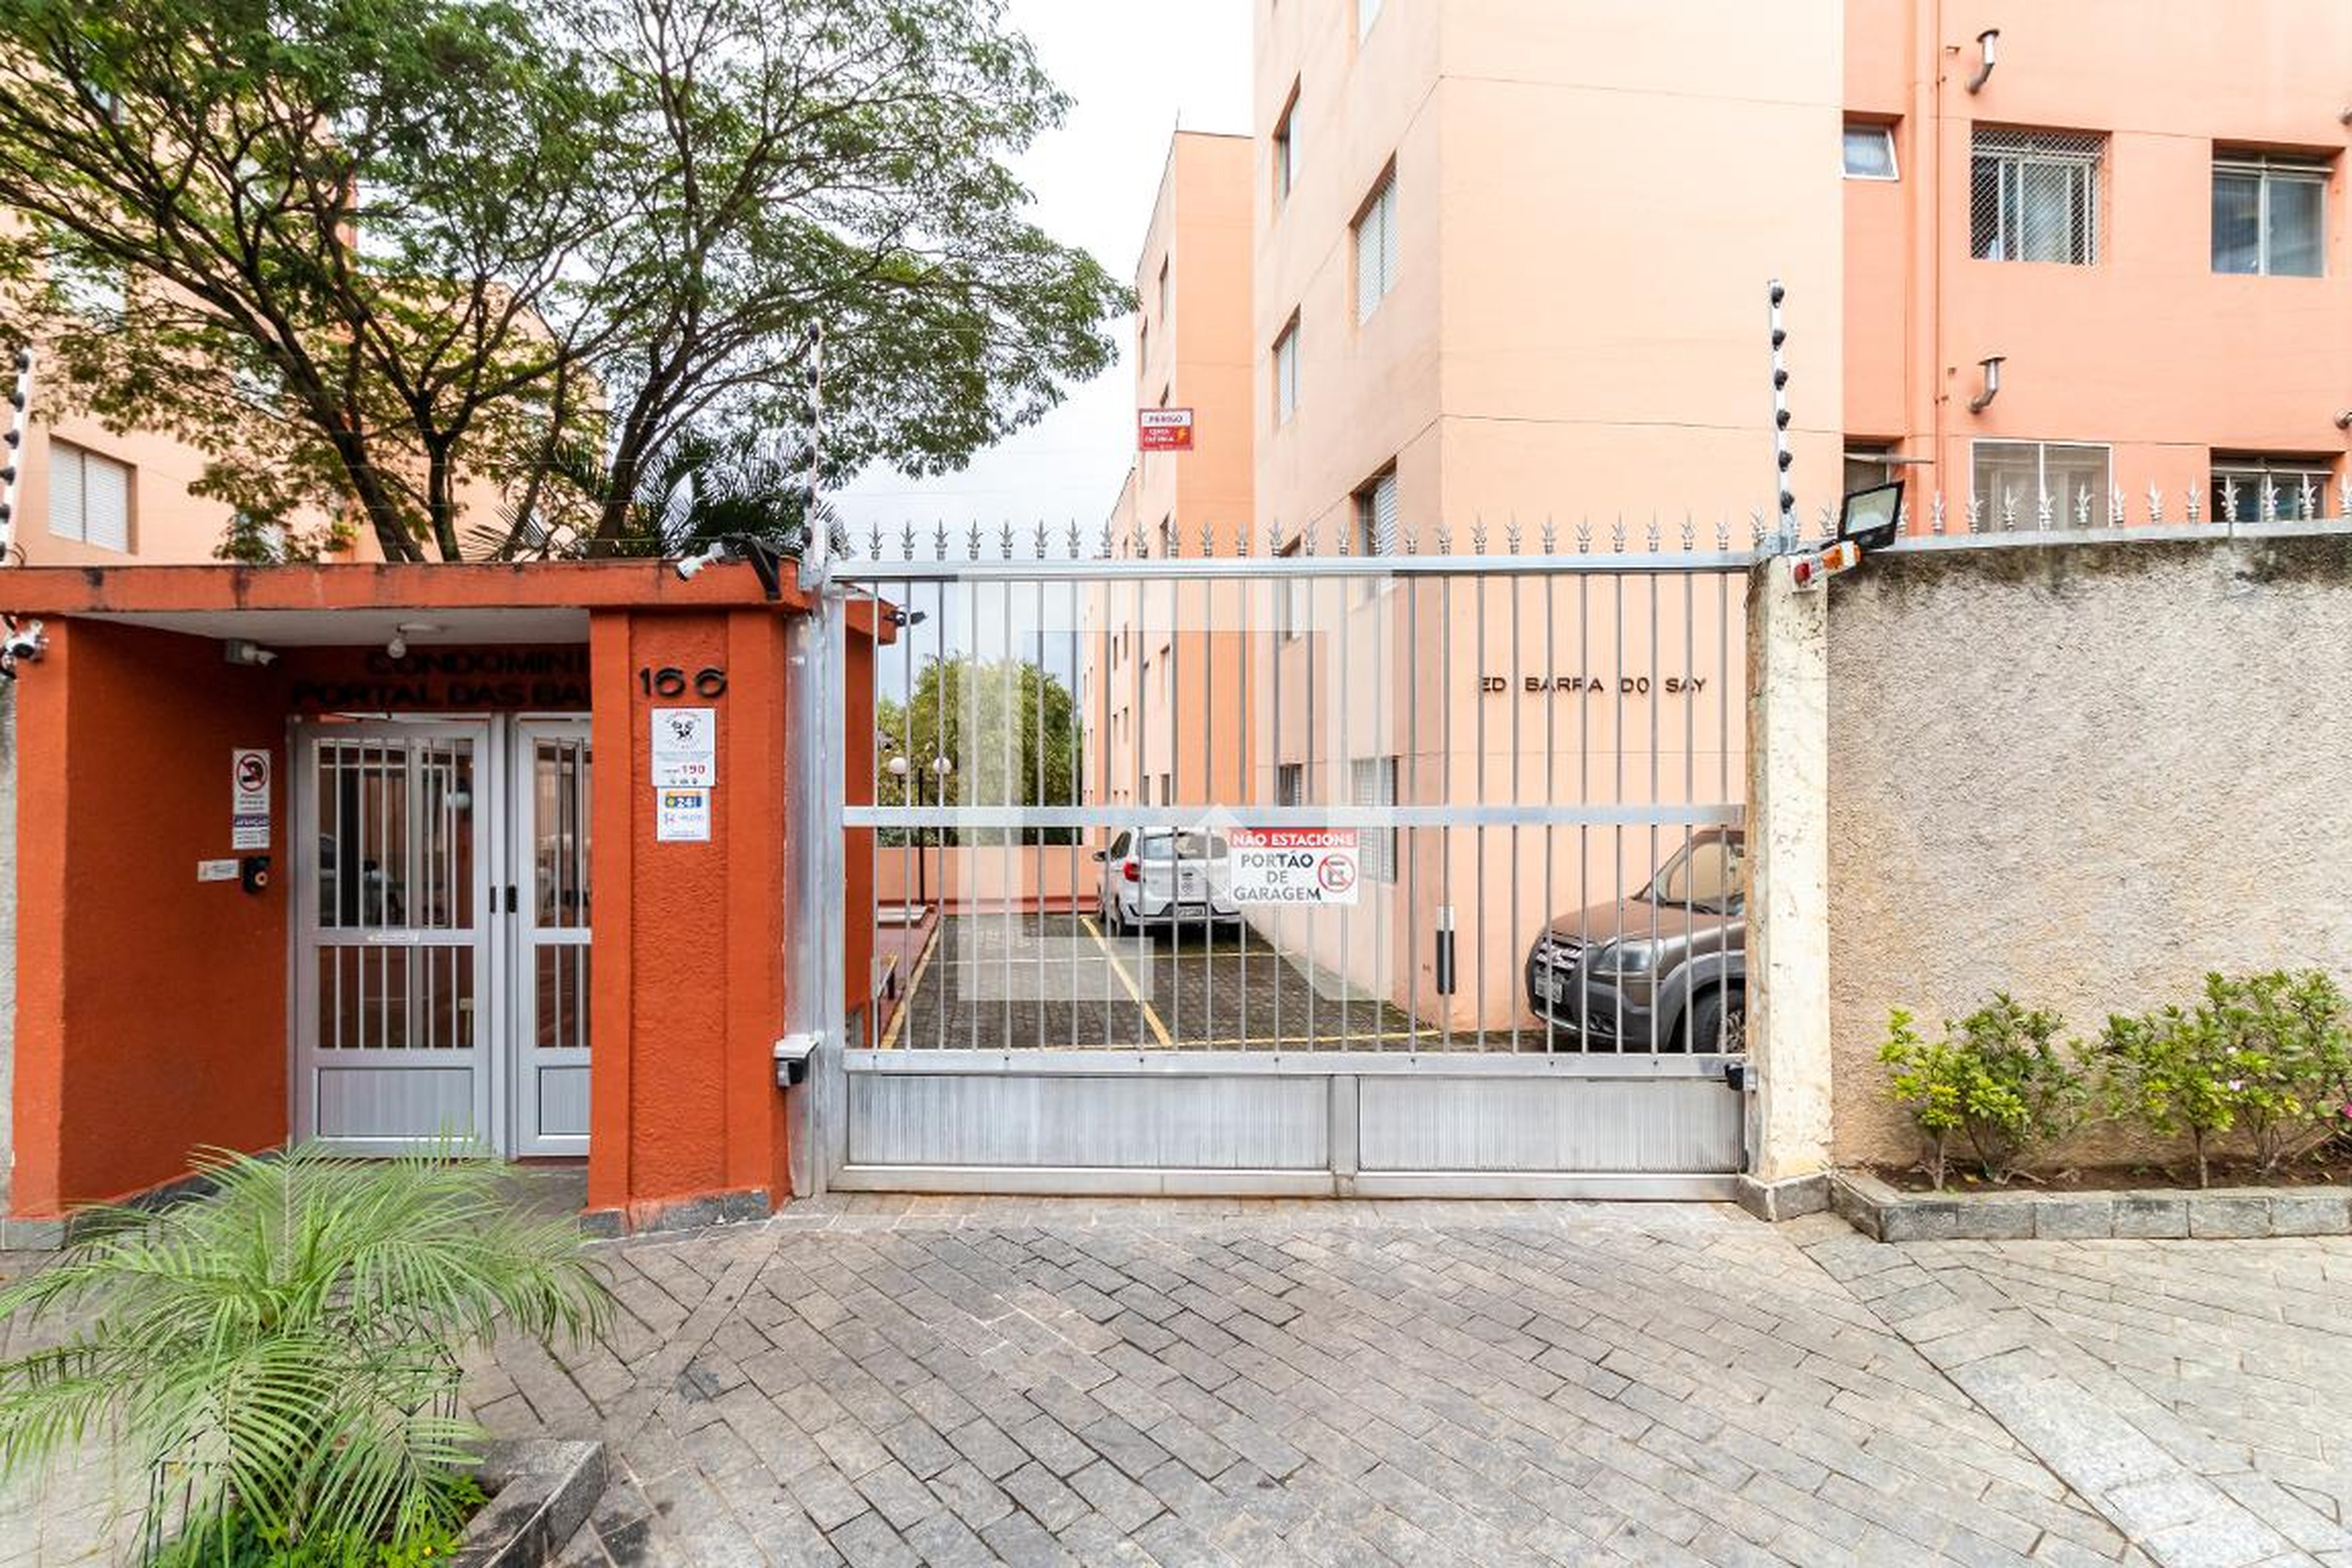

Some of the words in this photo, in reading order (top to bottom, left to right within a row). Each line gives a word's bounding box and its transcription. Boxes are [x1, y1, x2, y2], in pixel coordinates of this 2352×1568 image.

[639, 666, 728, 698] 166
[1481, 678, 1507, 692] ED
[1620, 677, 1650, 693] DO
[1233, 832, 1266, 845] NÃO
[1272, 833, 1354, 845] ESTACIONE
[1241, 850, 1314, 868] PORTÃO
[1267, 871, 1288, 884] DE
[1234, 888, 1322, 901] GARAGEM
